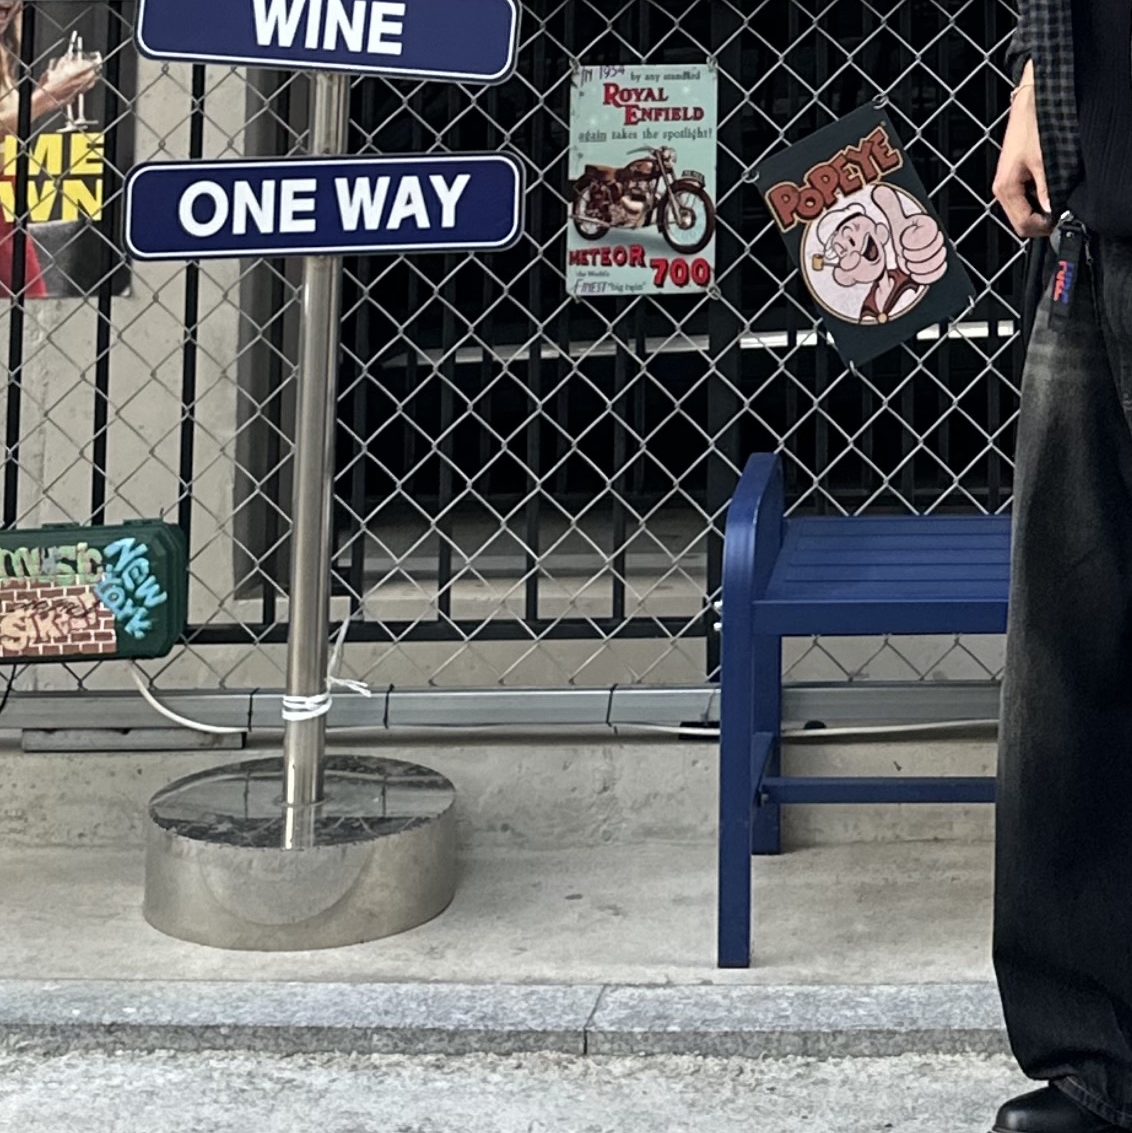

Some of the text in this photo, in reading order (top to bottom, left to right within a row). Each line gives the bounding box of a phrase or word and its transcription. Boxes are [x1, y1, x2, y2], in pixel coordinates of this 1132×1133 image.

[602, 82, 669, 108] ROYAL
[623, 104, 705, 126] ENFIELD
[611, 128, 638, 140] takes
[642, 128, 659, 140] the
[765, 126, 903, 232] POPEYE
[178, 173, 471, 237] ONE WAY
[569, 244, 711, 288] METEOR 700
